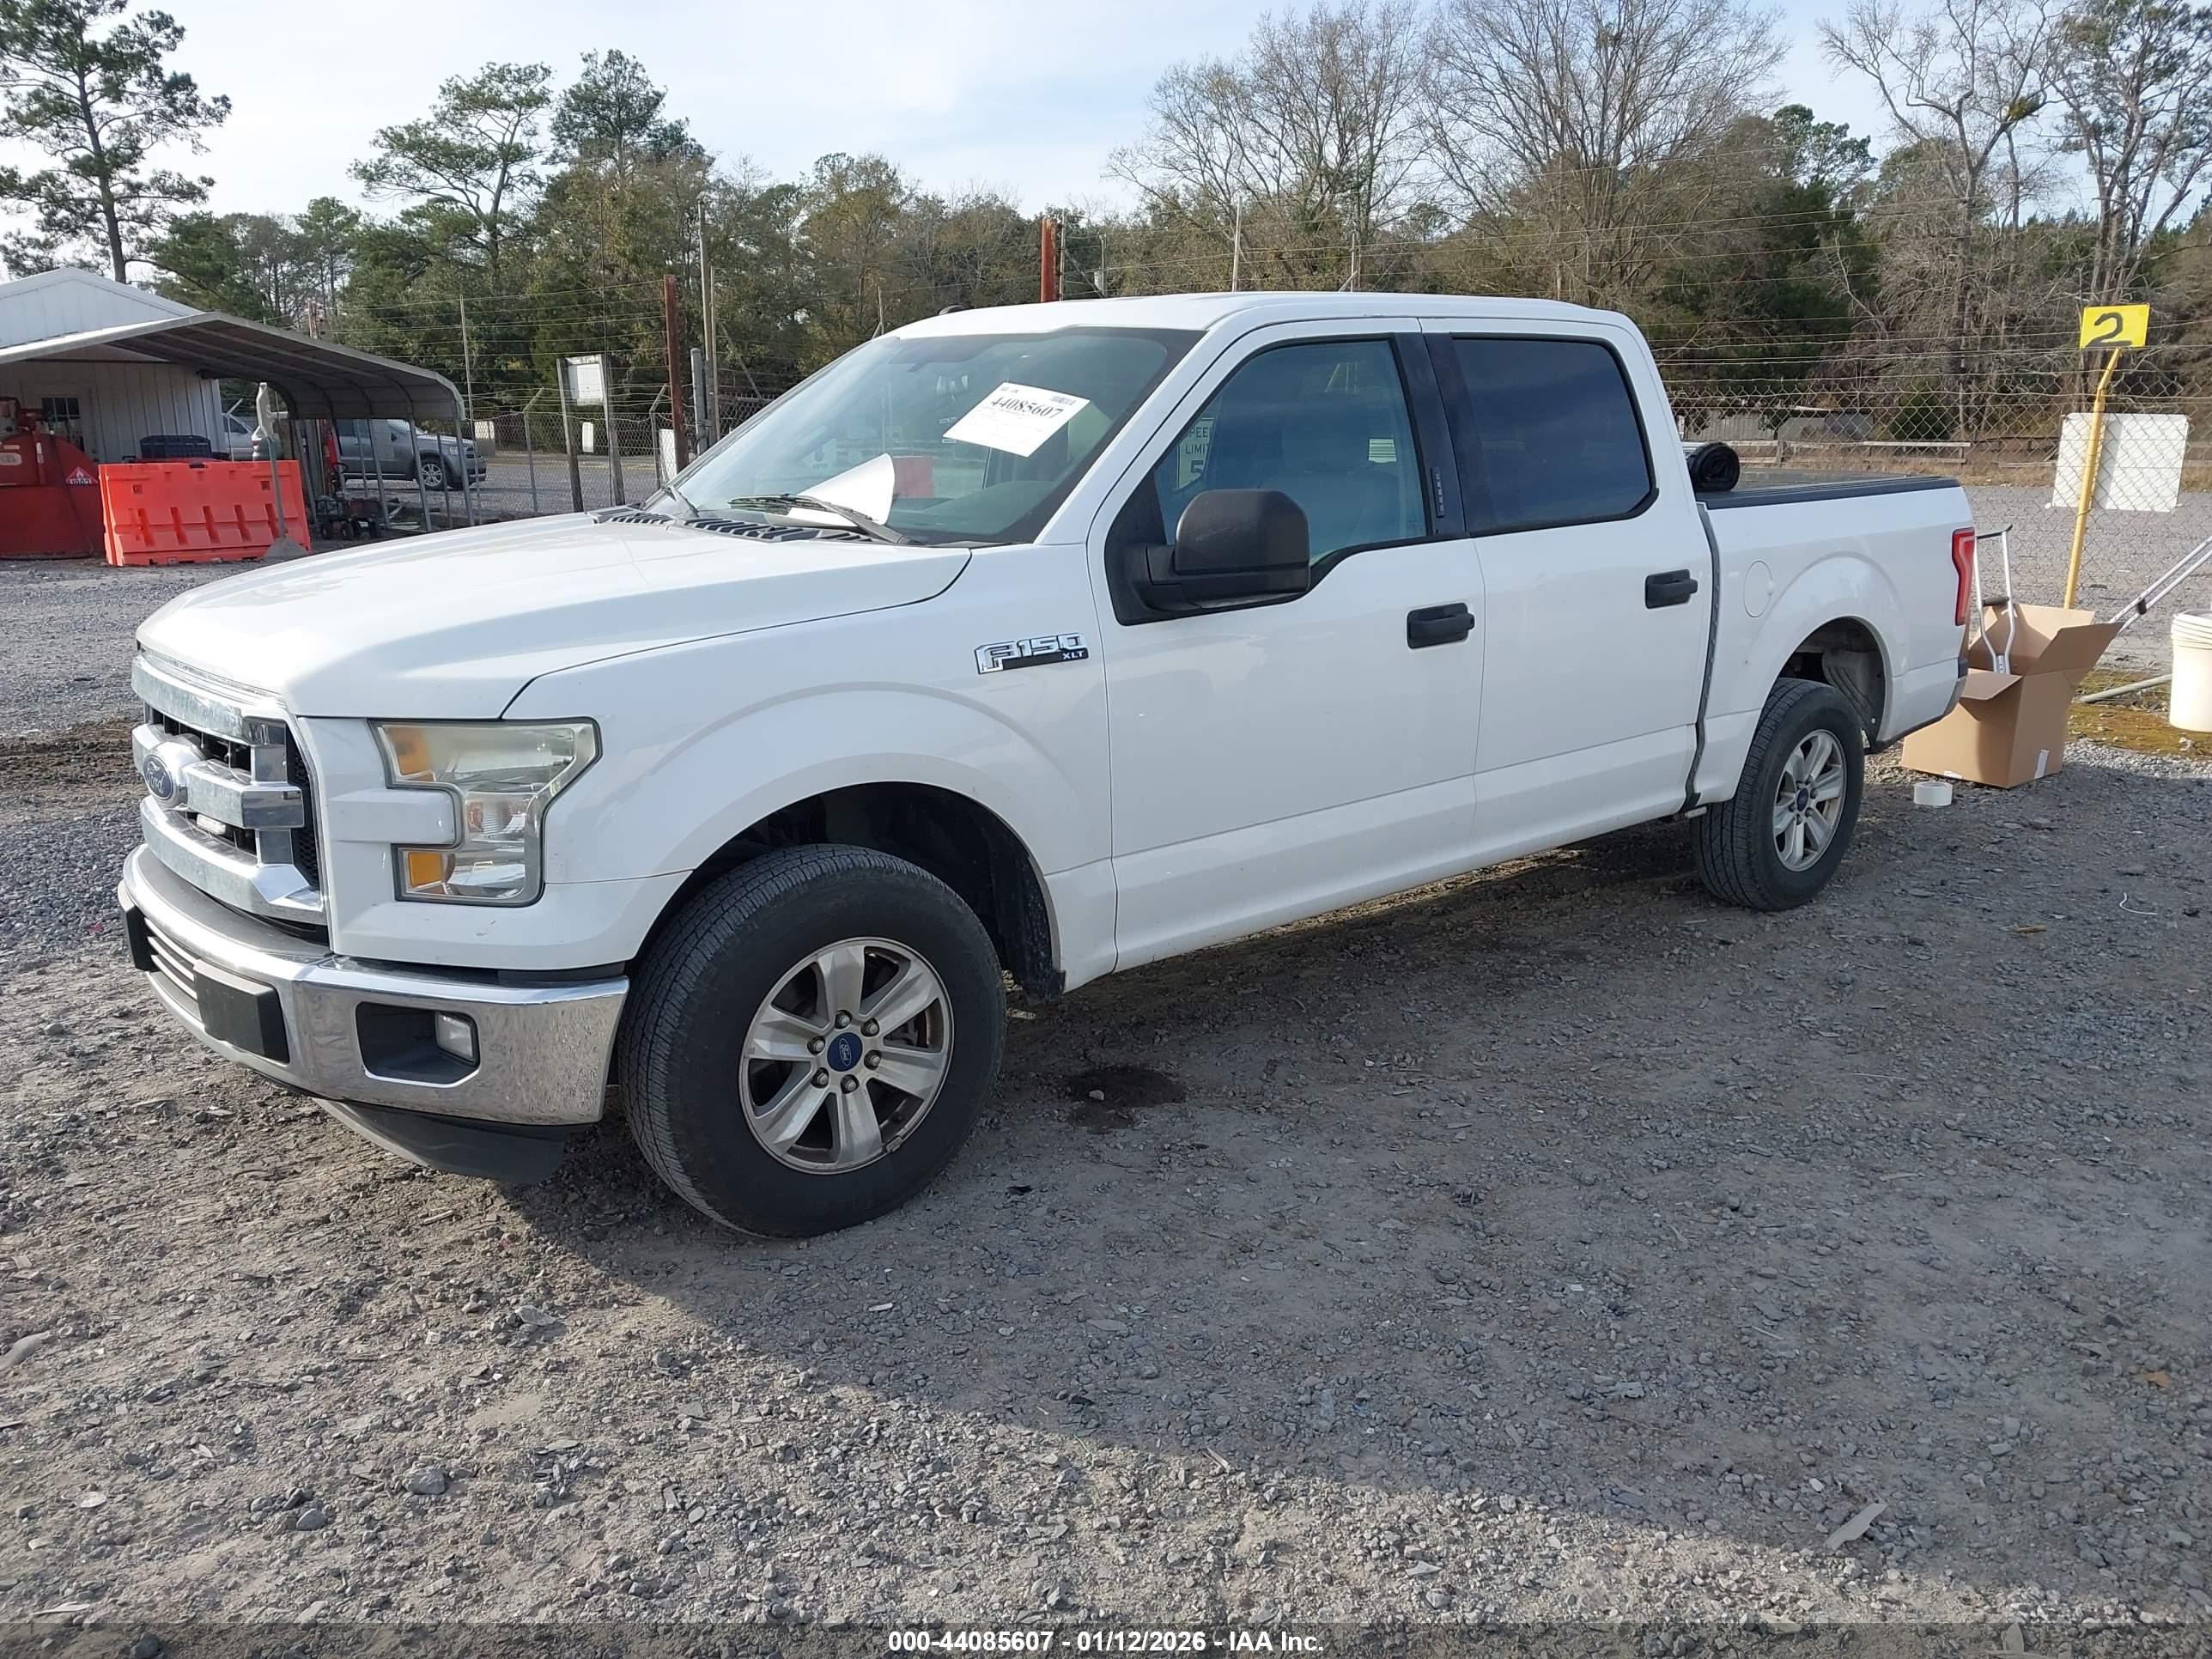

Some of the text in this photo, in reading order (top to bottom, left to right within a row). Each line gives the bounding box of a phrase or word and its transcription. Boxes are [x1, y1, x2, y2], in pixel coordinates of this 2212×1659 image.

[2084, 312, 2132, 348] 2
[991, 397, 1064, 419] 44085607
[1188, 427, 1210, 438] PEE
[1062, 650, 1085, 660] XLT
[147, 761, 166, 794] Ford
